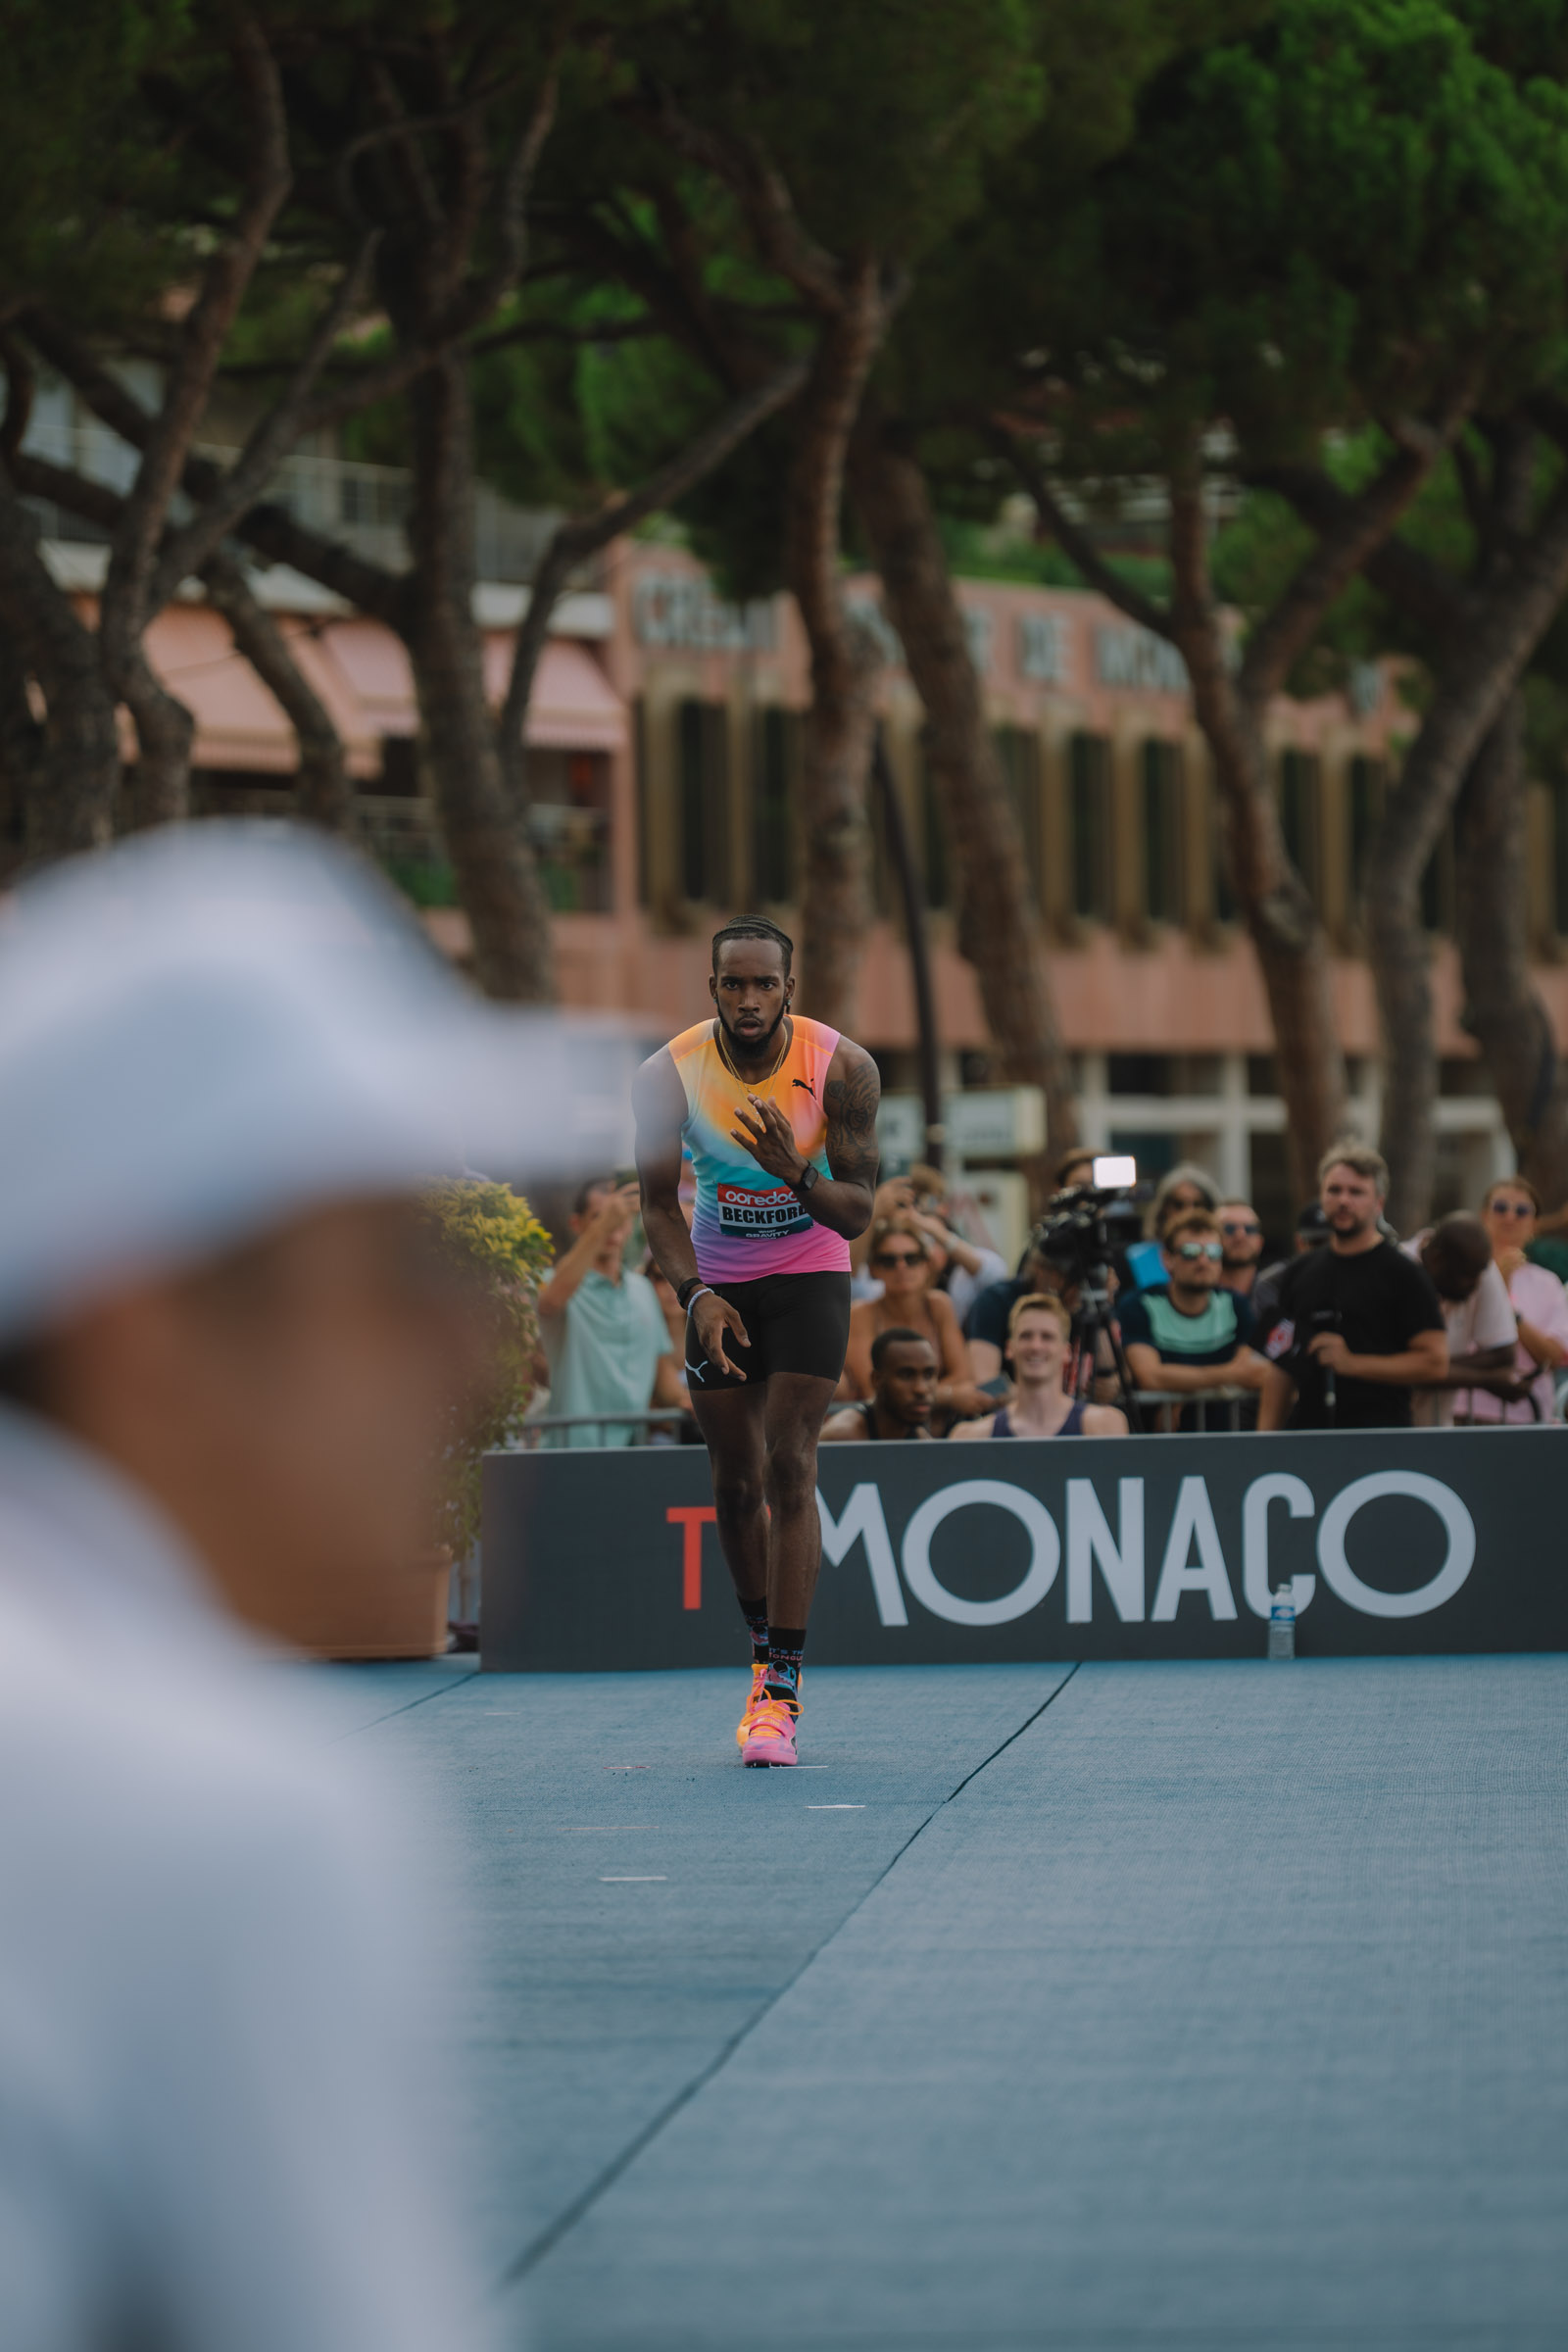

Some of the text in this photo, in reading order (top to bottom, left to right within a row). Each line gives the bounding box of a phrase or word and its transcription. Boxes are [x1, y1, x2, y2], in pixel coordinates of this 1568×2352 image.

[745, 1229, 790, 1238] GRAVITY
[815, 1470, 1476, 1627] MONACO
[768, 1652, 804, 1661] TONGU
